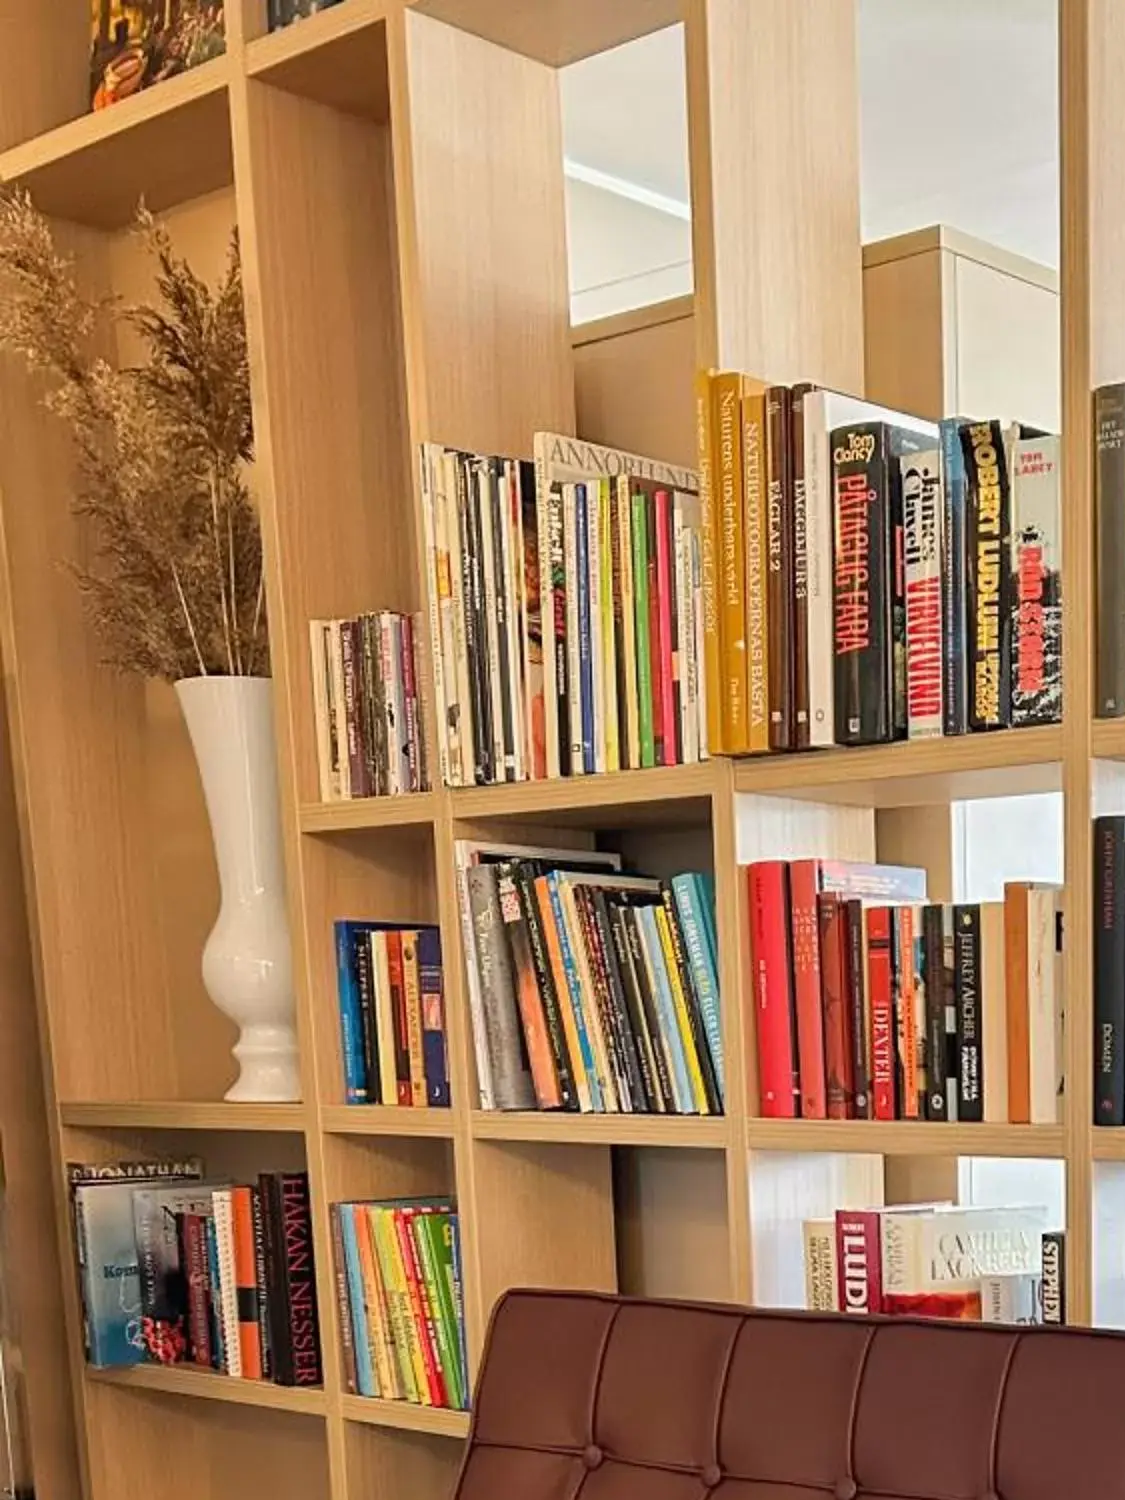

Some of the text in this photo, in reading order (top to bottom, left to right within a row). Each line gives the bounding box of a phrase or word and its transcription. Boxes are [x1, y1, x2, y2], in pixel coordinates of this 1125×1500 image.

[721, 390, 734, 469] Naturens
[834, 447, 875, 463] Clancy
[847, 433, 875, 449] Tom
[767, 480, 781, 572] FÅGLAR 2
[904, 468, 922, 565] Clavell
[920, 467, 941, 562] James
[969, 422, 1000, 652] ROBERT LUDLUM
[744, 420, 766, 727] NATURFOTOGRAFERNAS BÄSTA
[795, 586, 806, 599] 3
[835, 472, 877, 656] PÅTAGLIG FARA
[905, 575, 941, 719] VIRVELVIND
[958, 931, 976, 984] JEFFREY
[873, 1007, 890, 1084] DEXTER
[962, 985, 978, 1040] ARCHER
[1102, 1022, 1113, 1073] DOMEN
[281, 1176, 318, 1384] HÅKAN NESSER
